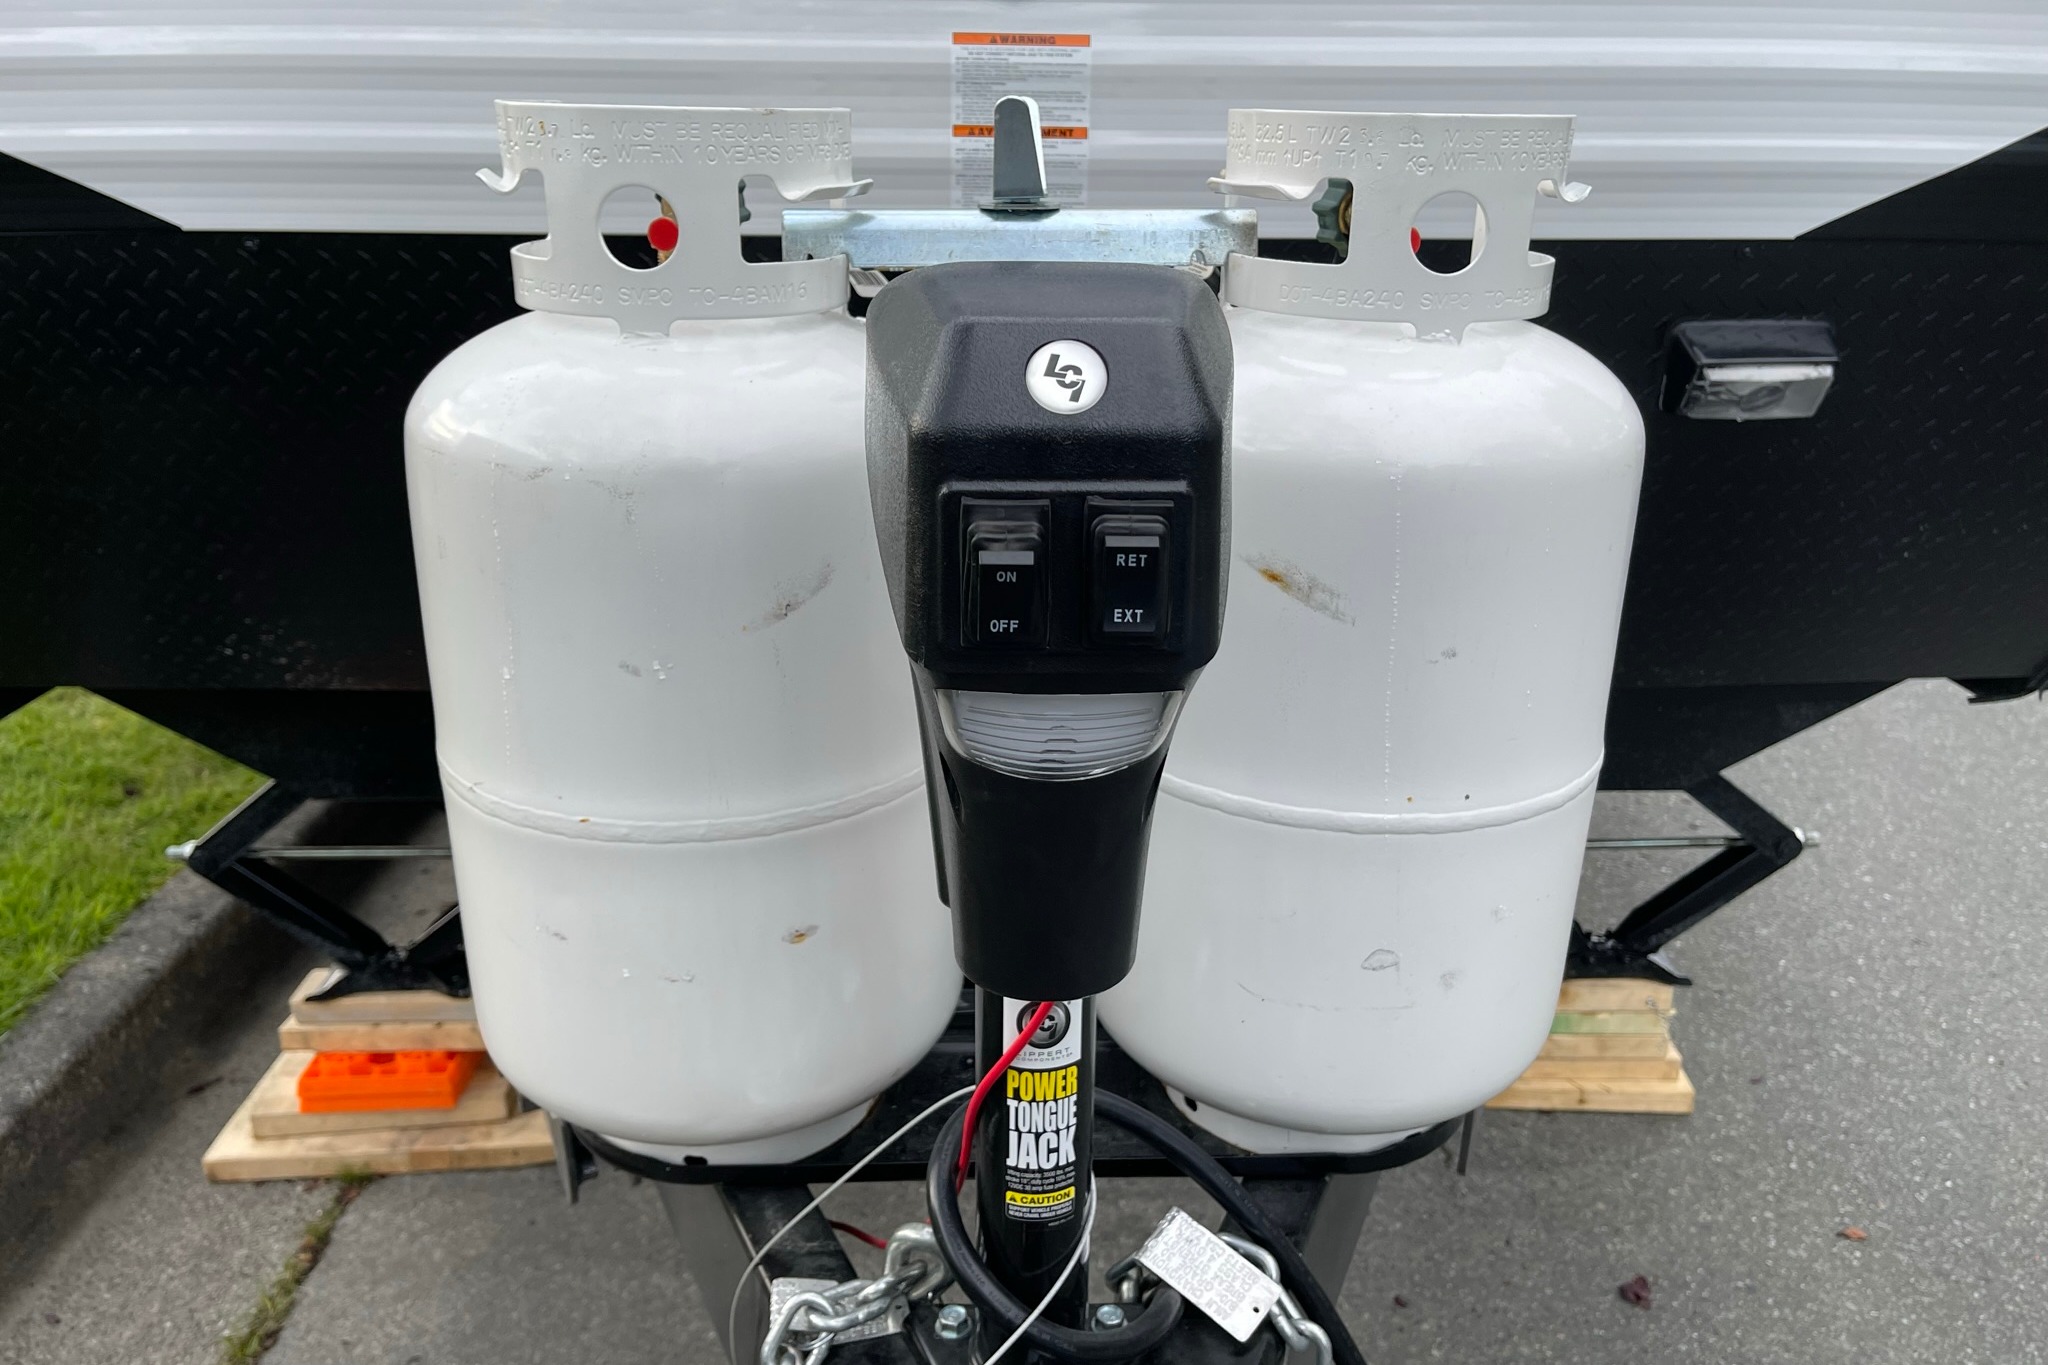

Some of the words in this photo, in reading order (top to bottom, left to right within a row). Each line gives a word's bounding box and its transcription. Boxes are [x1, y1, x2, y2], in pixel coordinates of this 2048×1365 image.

[1000, 35, 1056, 45] WARNING
[676, 122, 702, 141] BE
[1500, 129, 1521, 148] BE
[720, 144, 781, 165] YEARS
[1116, 554, 1148, 567] RET
[996, 572, 1017, 583] ON
[1114, 609, 1143, 622] EXT
[990, 620, 1019, 632] OFF
[1006, 1065, 1078, 1101] POWER
[1006, 1094, 1077, 1133] TONGUE
[1006, 1124, 1077, 1170] JACK
[1020, 1190, 1071, 1205] CAUTION
[1176, 1259, 1216, 1294] GRADE
